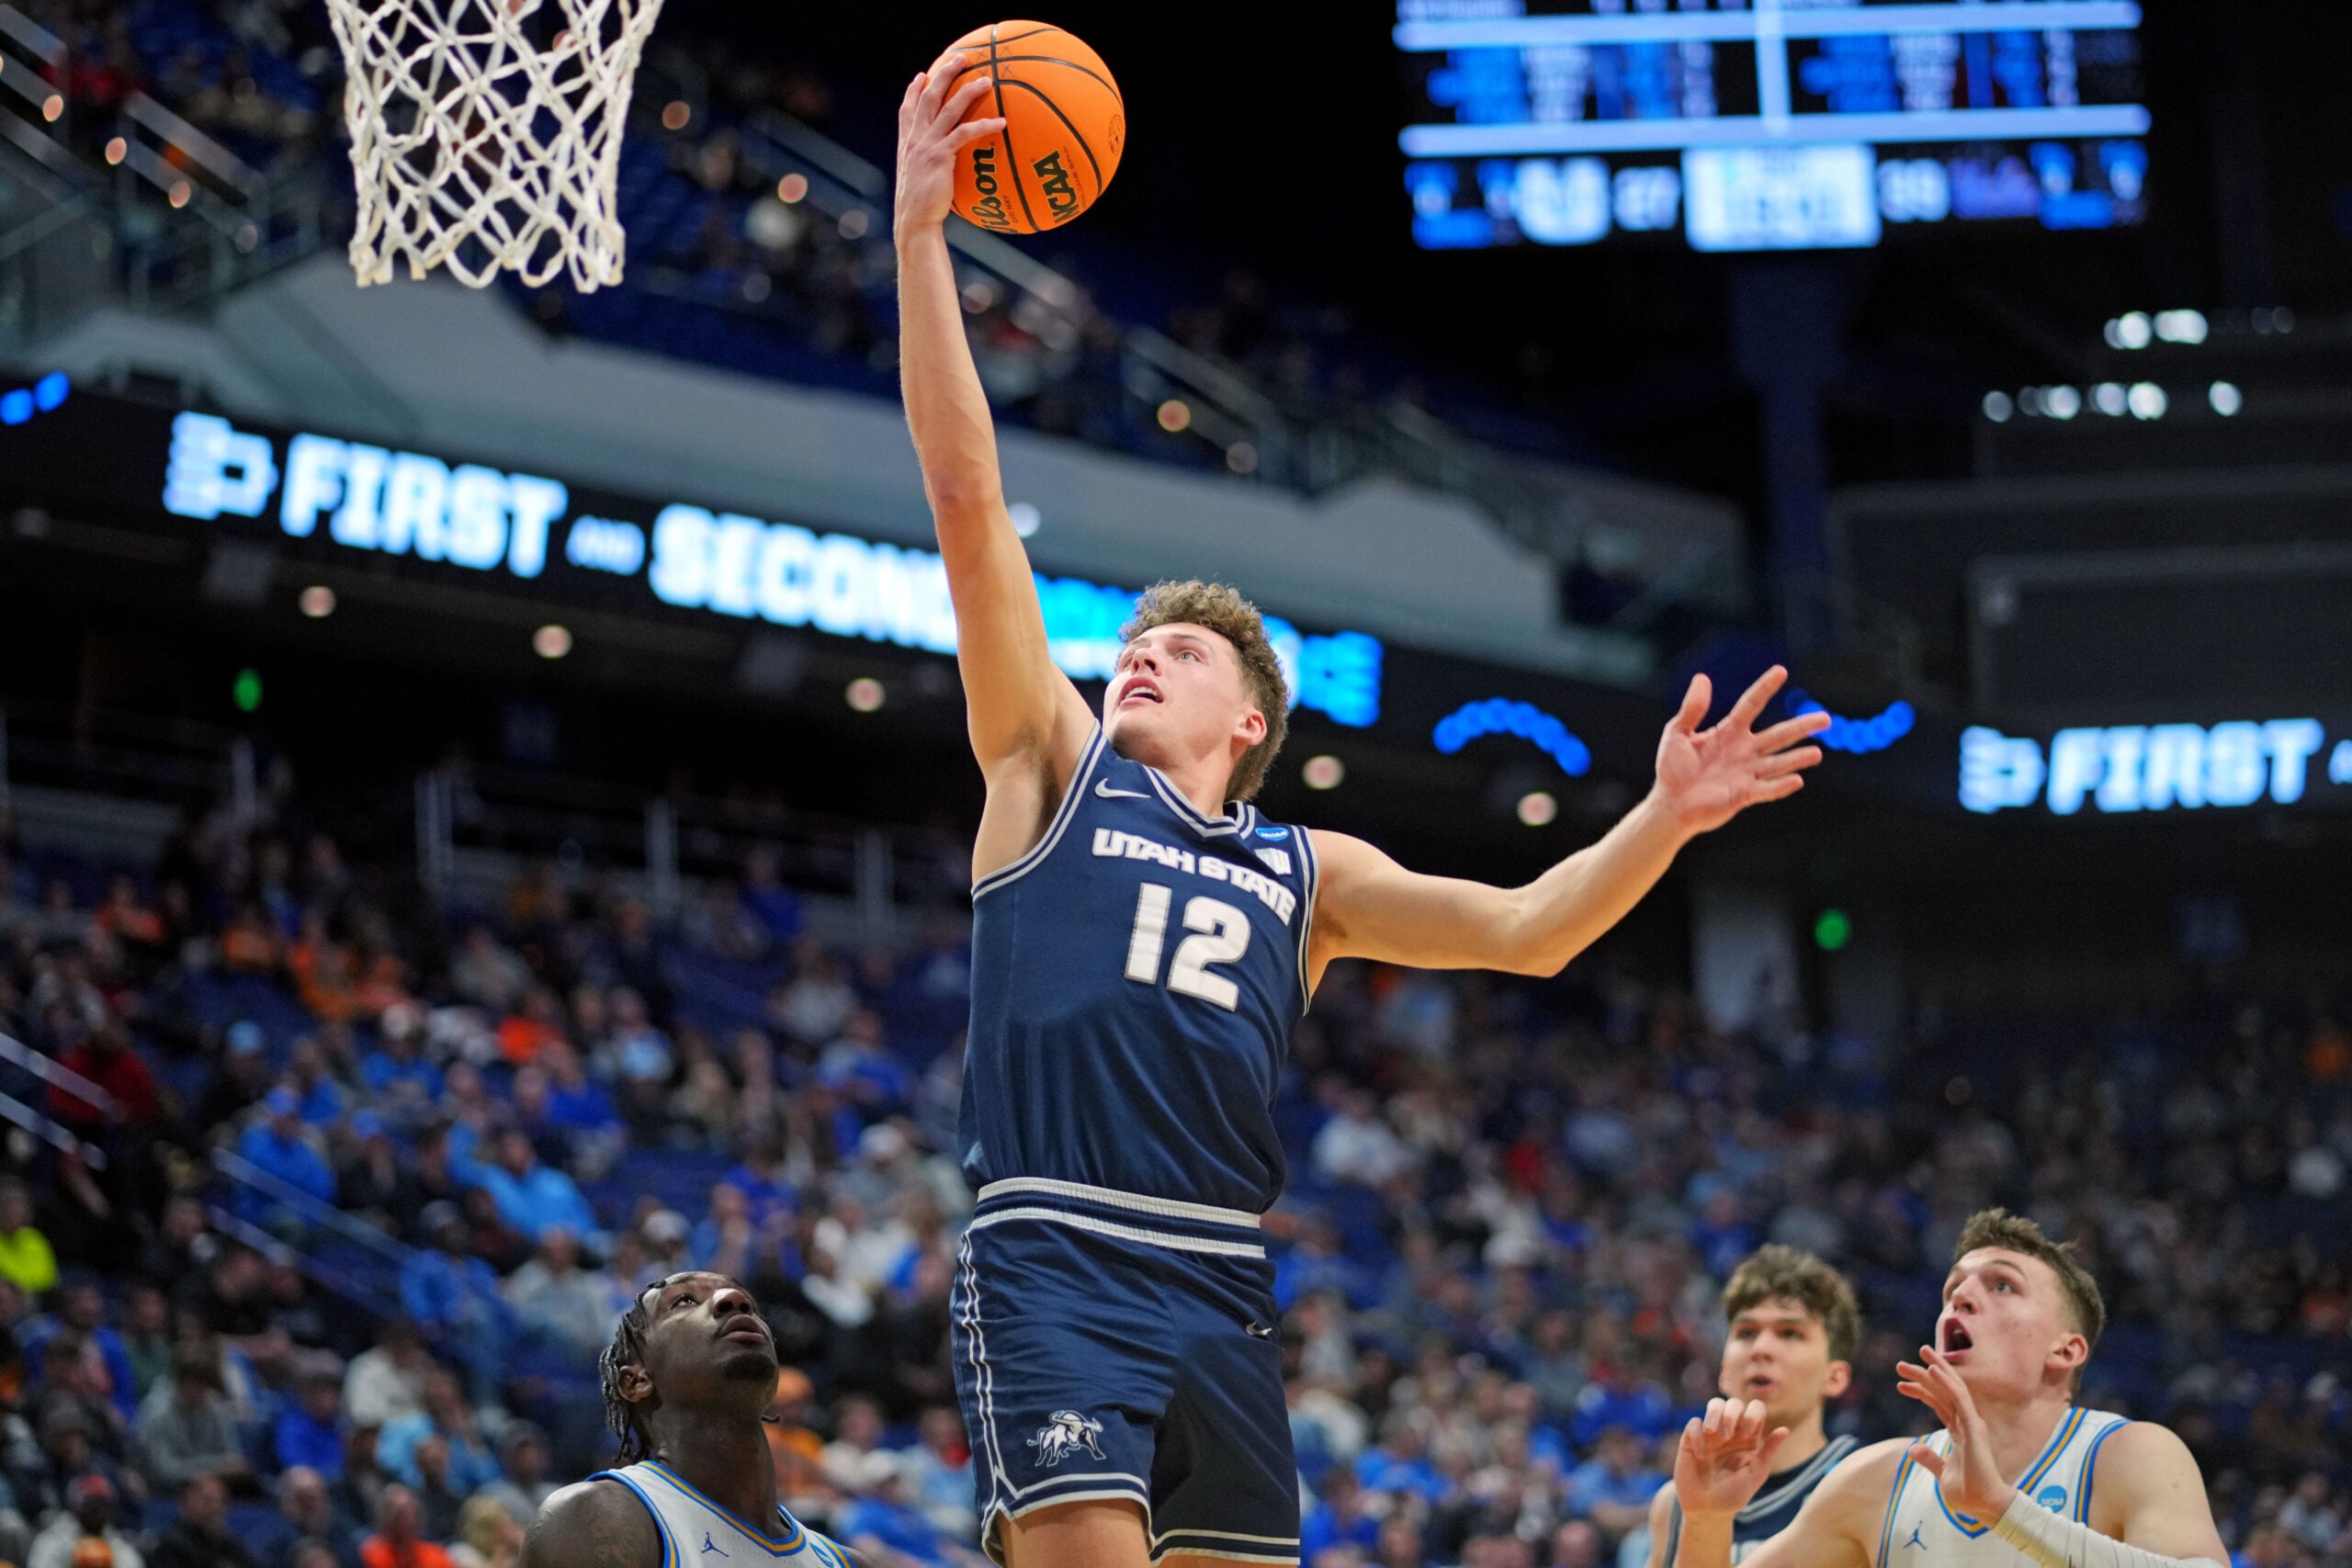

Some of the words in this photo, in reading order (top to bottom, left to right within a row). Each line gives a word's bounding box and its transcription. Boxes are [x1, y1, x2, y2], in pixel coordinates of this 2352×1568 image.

[1032, 149, 1080, 224] NCAA
[282, 433, 567, 578] FIRST
[2048, 717, 2324, 815] FIRST
[1091, 828, 1196, 874] UTAH
[1198, 855, 1297, 927] STATE
[1123, 882, 1251, 1012] 12
